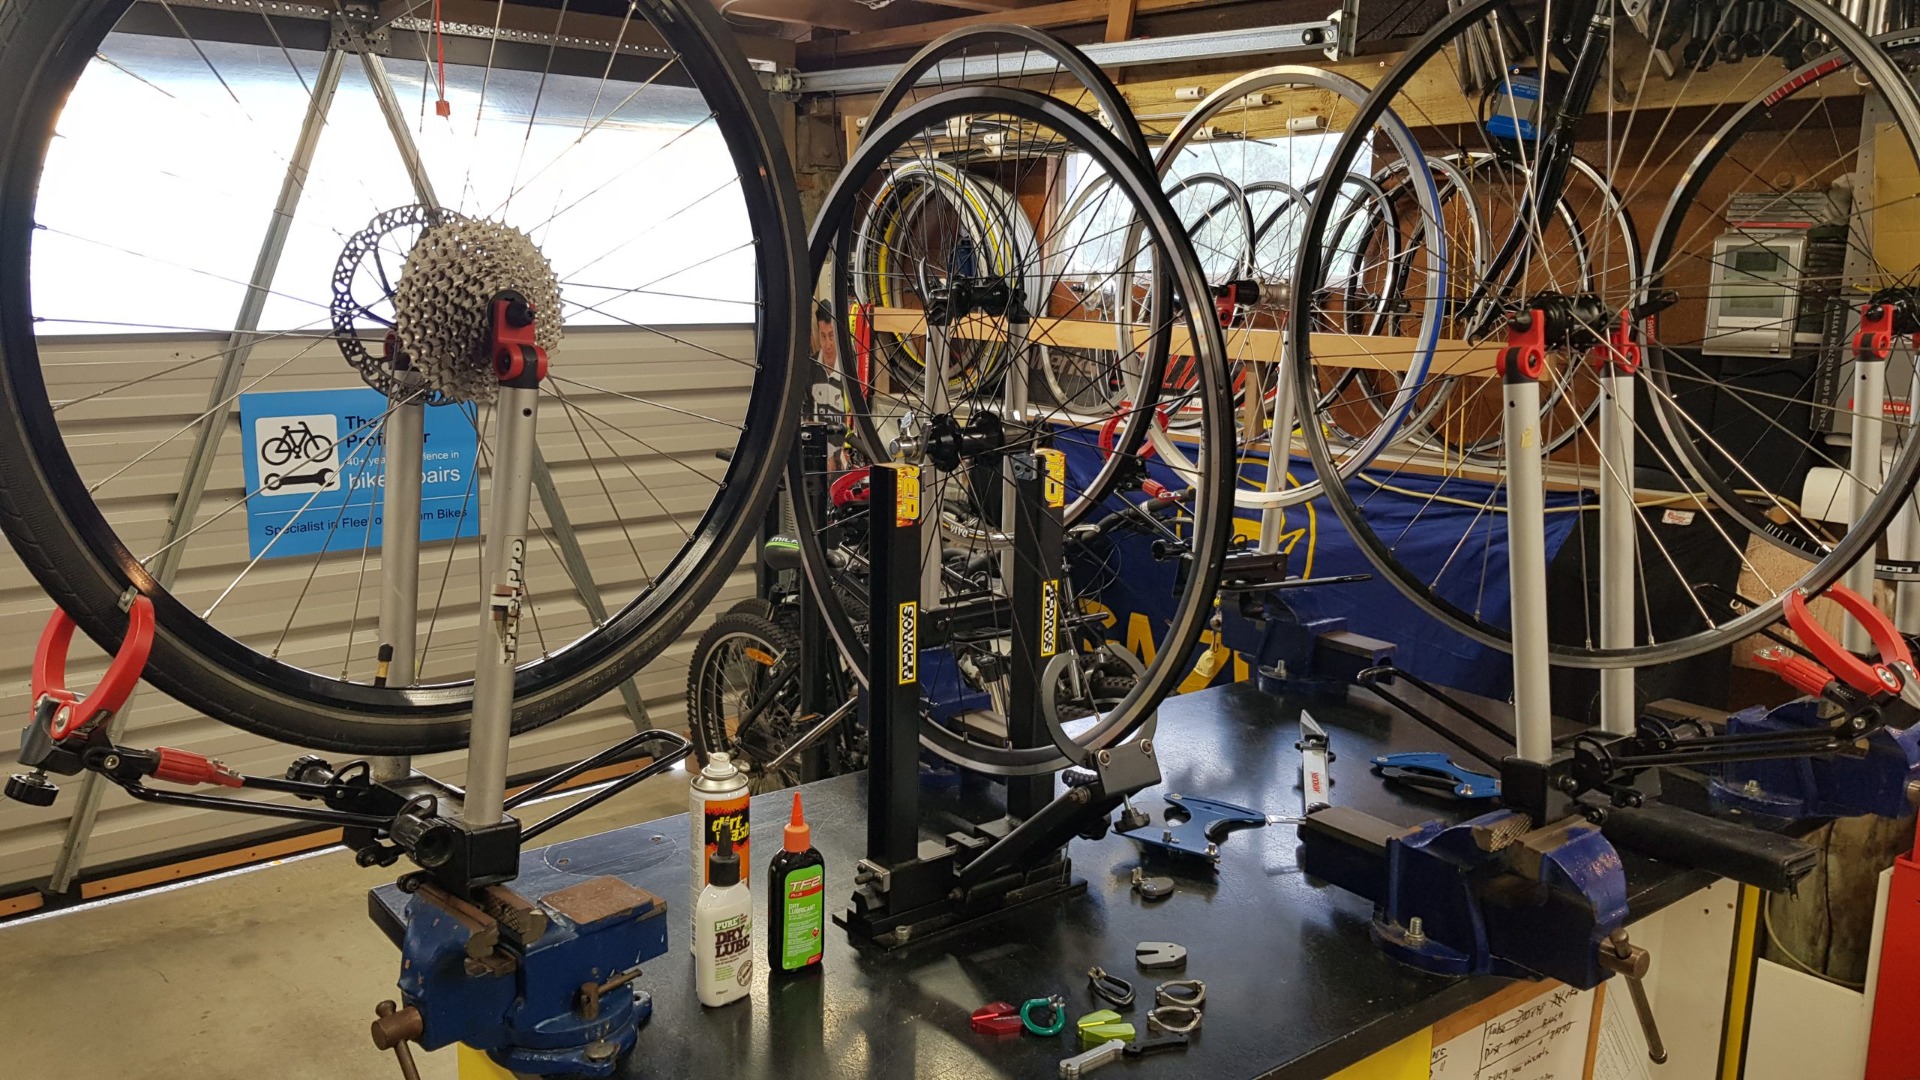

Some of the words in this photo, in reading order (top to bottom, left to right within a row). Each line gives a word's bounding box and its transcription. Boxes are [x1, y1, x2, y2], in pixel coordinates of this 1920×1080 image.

[345, 415, 378, 429] The
[346, 430, 431, 448] Profr
[368, 456, 386, 467] yea
[451, 451, 460, 459] in
[348, 471, 385, 490] bike
[264, 520, 325, 536] Specialist
[342, 516, 371, 529] Flee
[437, 508, 467, 519] Bikes
[716, 821, 750, 842] ash
[789, 875, 821, 892] TF2
[715, 917, 740, 931] PURE
[715, 924, 746, 945] DRY
[715, 933, 750, 959] LUBE
